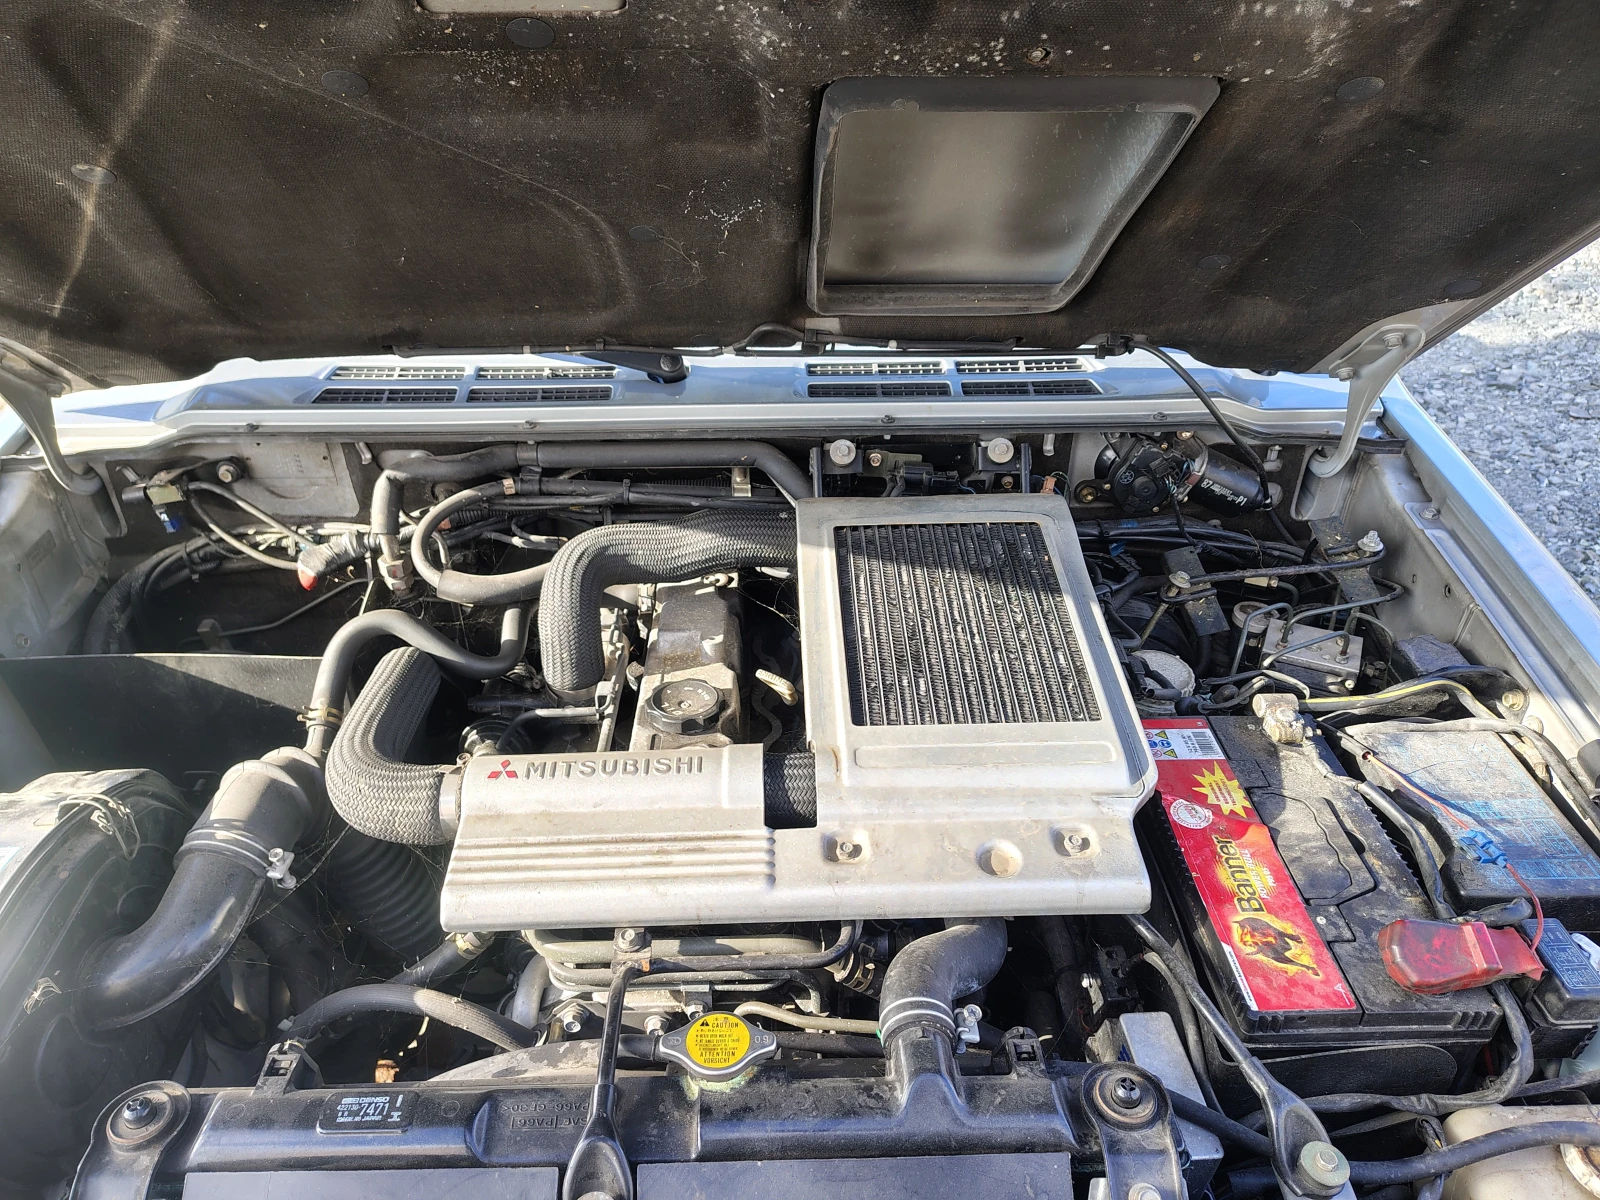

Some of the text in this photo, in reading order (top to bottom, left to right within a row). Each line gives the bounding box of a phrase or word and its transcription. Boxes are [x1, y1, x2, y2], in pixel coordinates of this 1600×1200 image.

[1200, 478, 1213, 489] 87
[1235, 495, 1248, 507] P1
[522, 755, 703, 780] MITSUBISHI
[1212, 835, 1266, 913] Banner
[1240, 849, 1271, 900] POWER BULL
[754, 1035, 769, 1044] 0.9
